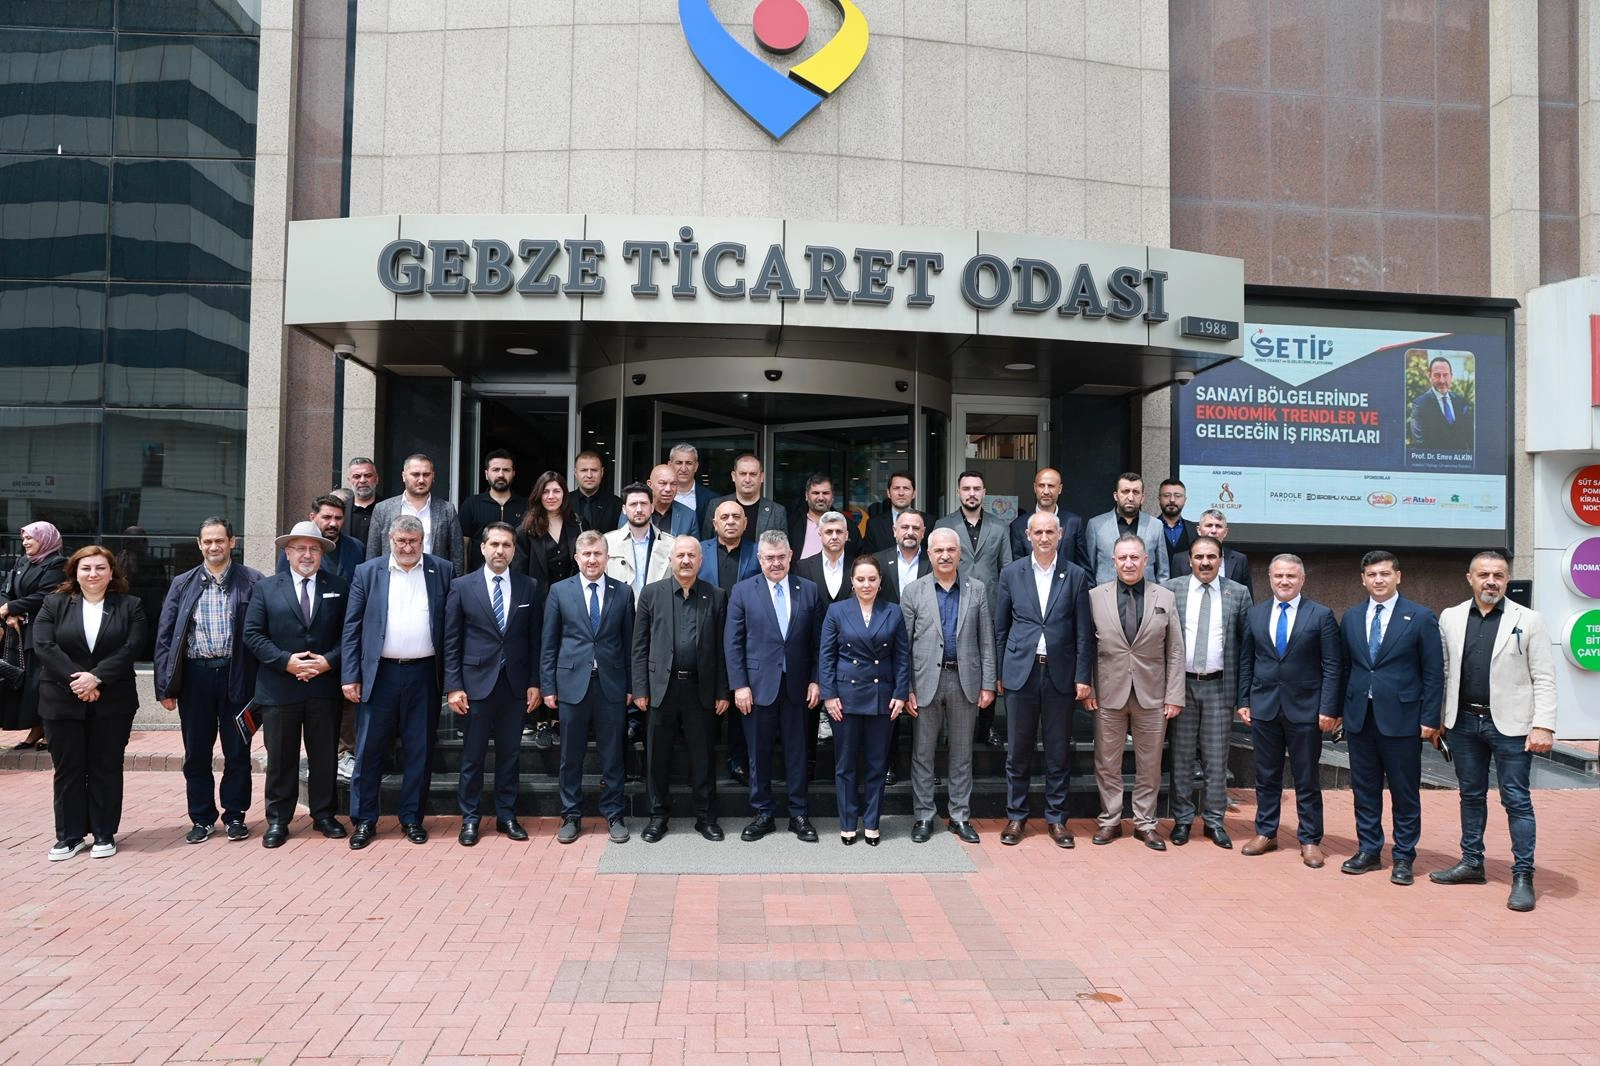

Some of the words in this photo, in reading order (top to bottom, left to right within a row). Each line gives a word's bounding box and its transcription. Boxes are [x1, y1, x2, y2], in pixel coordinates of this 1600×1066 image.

[377, 239, 605, 295] GEBZE
[622, 226, 944, 306] TİCARET
[960, 254, 1169, 323] ODASI
[1200, 321, 1227, 335] 1988
[1196, 385, 1253, 403] SANAYİ
[1257, 387, 1368, 407] BÖLGELERİNDE
[1196, 404, 1277, 421] EKONOMİK
[1281, 408, 1356, 424] TRENDLER
[1360, 411, 1379, 425] VE
[1196, 423, 1279, 440] GELECEĞİN
[1283, 423, 1297, 444] İŞ
[1301, 427, 1380, 443] FIRSATLARI
[1578, 478, 1591, 486] SÜT
[1270, 491, 1302, 499] PARDOLE
